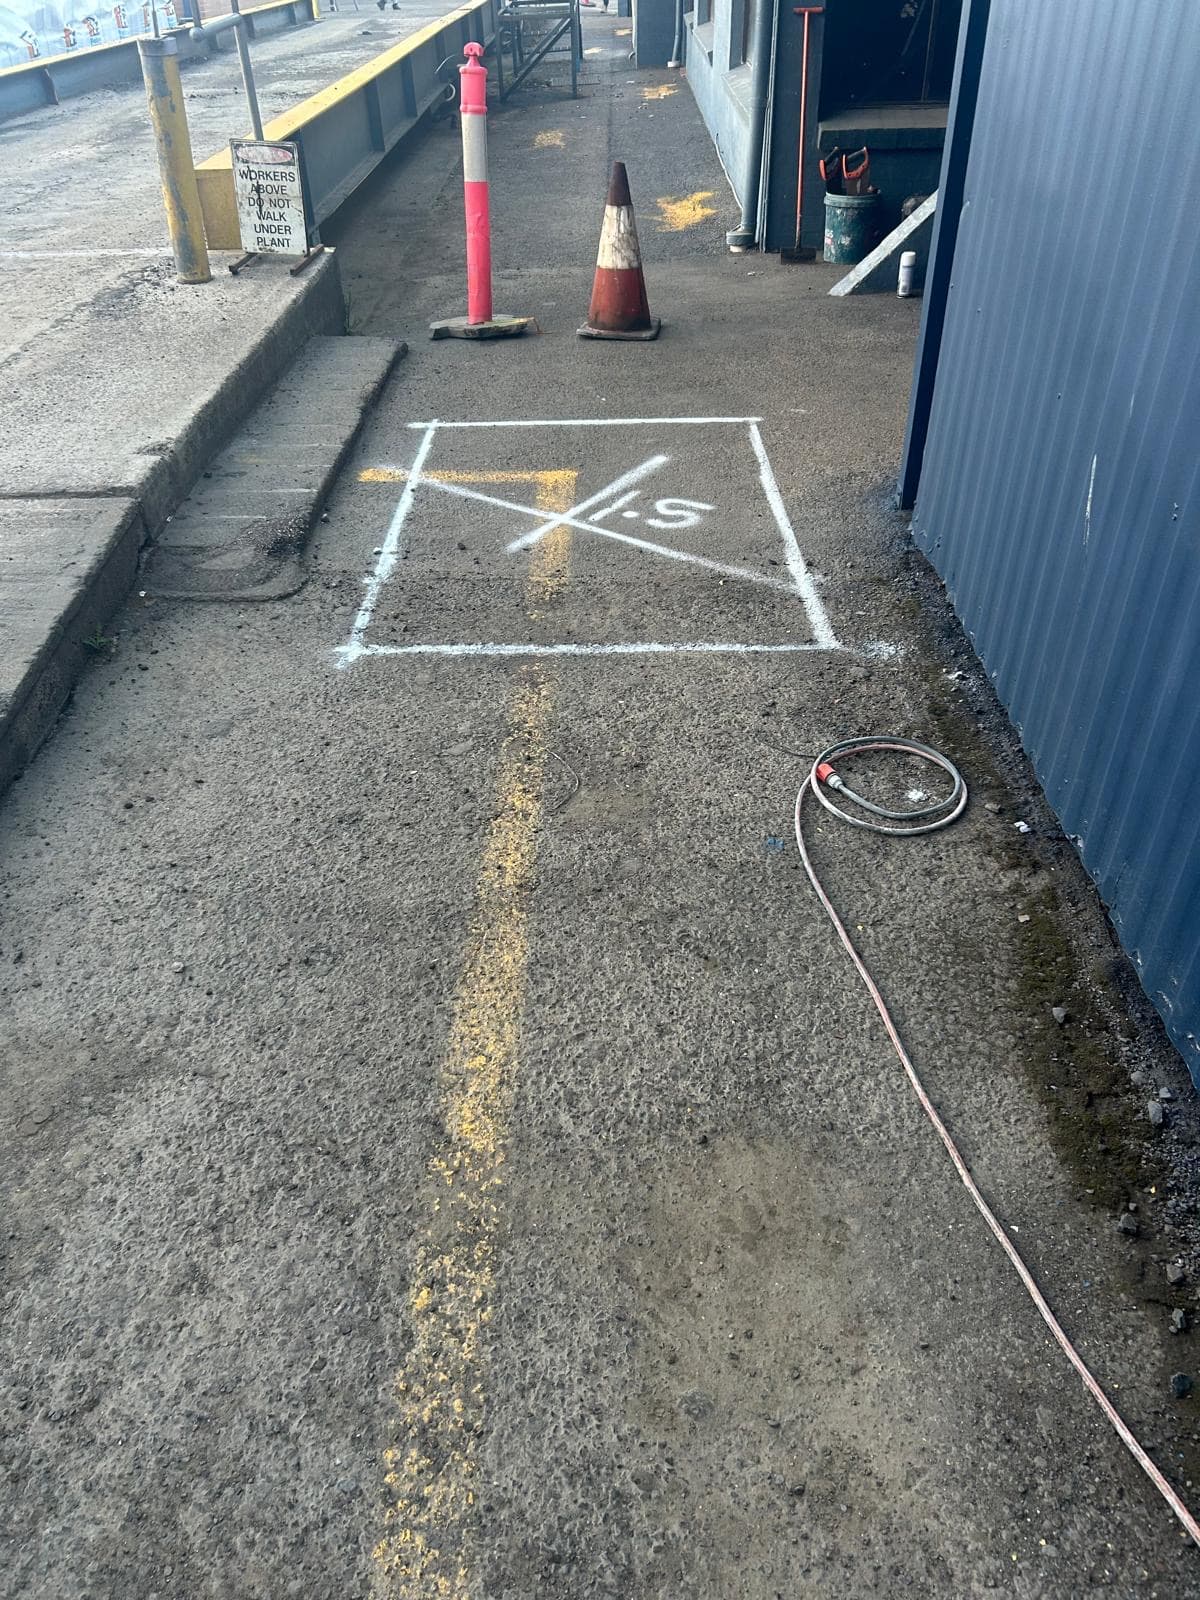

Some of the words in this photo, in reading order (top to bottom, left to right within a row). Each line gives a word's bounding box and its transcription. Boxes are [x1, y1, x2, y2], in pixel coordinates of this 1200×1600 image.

[239, 169, 295, 182] WORKERS
[251, 184, 287, 195] ABOVE
[248, 197, 264, 207] DO
[270, 198, 291, 208] NOT
[256, 211, 287, 222] WALK
[254, 224, 291, 235] UNDER
[257, 237, 291, 248] PLANT
